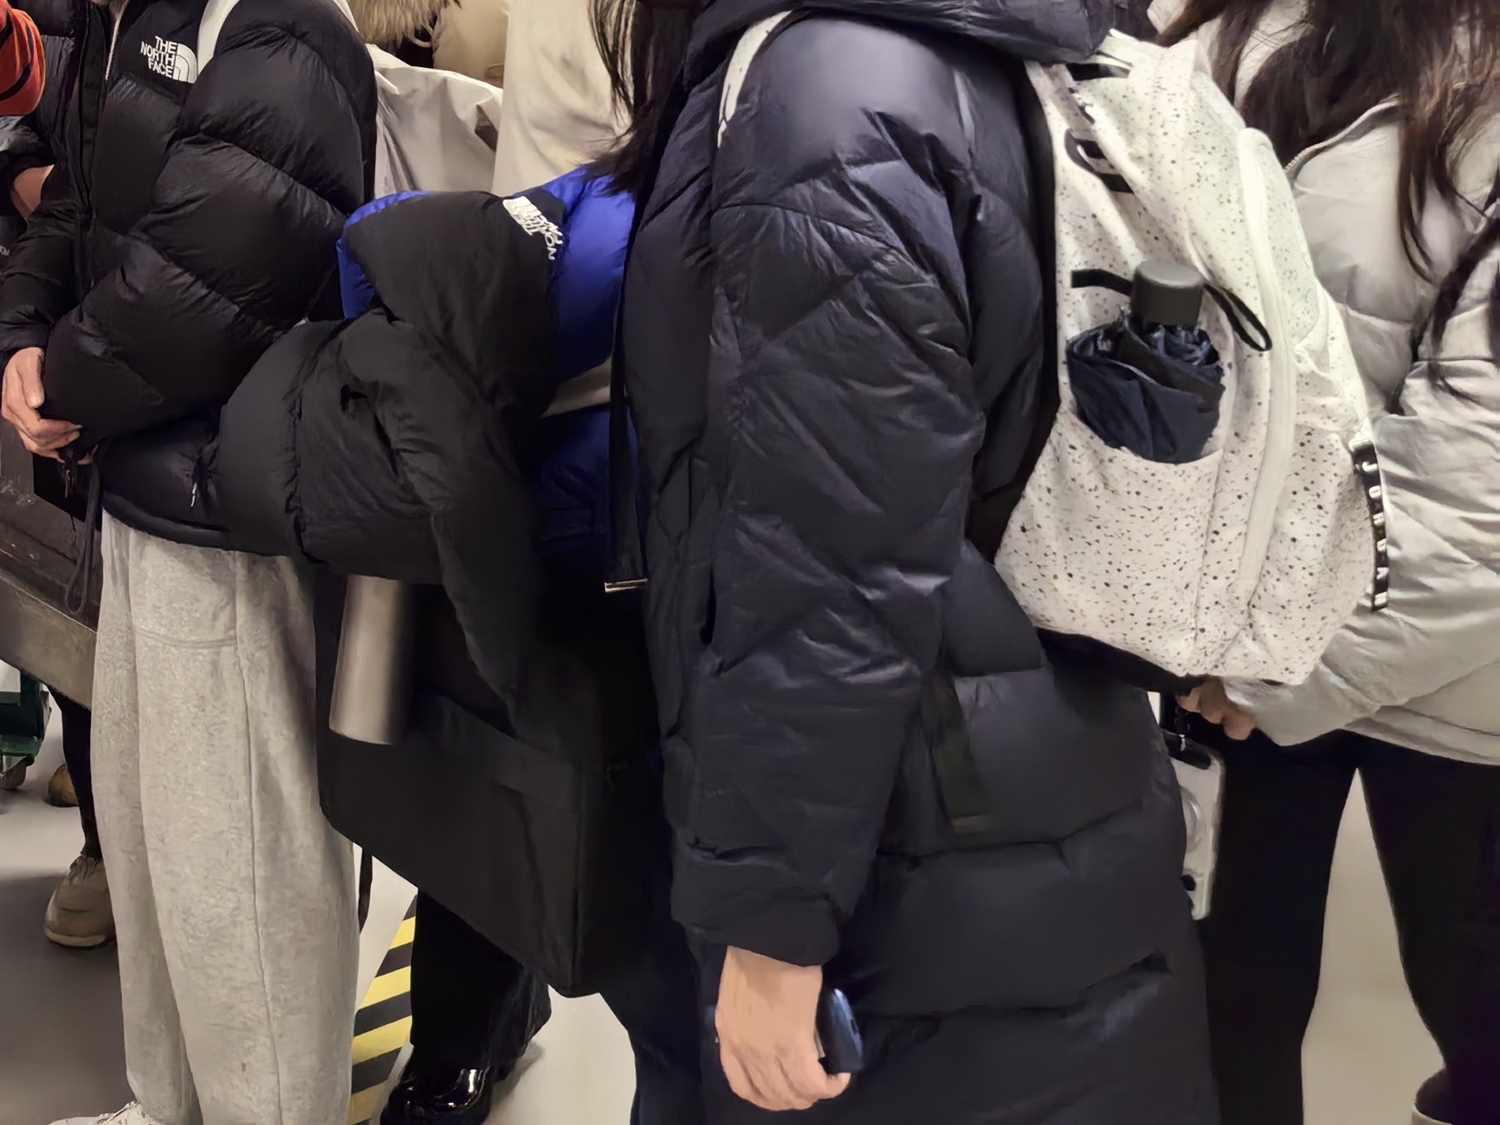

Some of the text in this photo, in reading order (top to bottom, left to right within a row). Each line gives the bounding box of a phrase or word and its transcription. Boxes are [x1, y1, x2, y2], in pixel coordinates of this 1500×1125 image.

[140, 41, 176, 67] NORTH
[155, 35, 178, 55] THE
[148, 57, 174, 79] FACE
[1361, 461, 1389, 606] JORDAN
